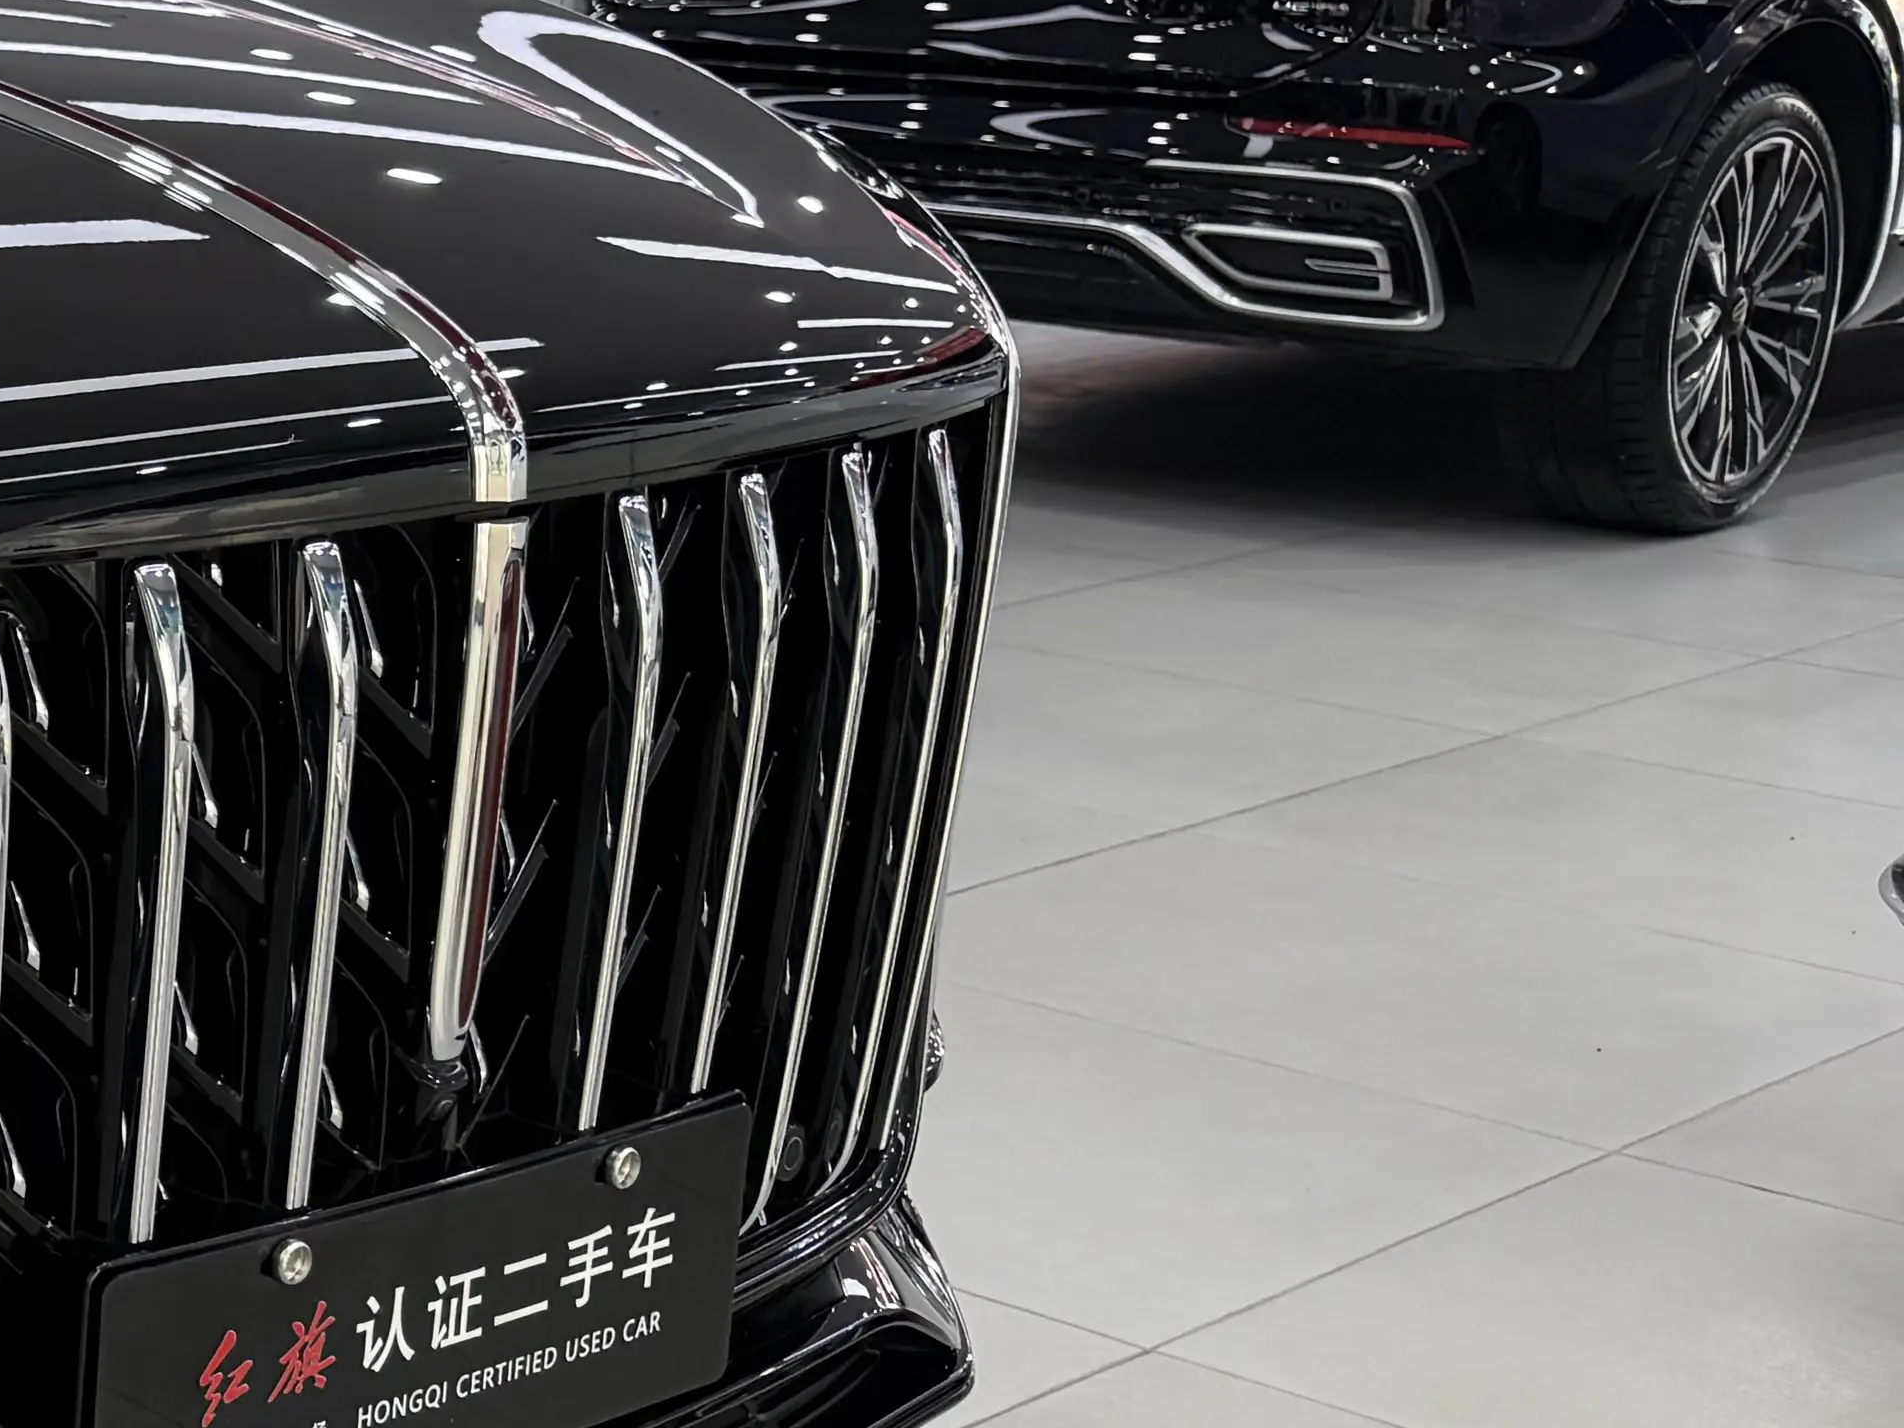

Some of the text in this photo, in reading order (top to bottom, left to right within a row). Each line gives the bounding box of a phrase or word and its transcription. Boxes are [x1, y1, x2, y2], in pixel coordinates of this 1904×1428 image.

[197, 1206, 676, 1428] 红旗 认证二手车
[457, 1347, 558, 1400] CERTIFIED
[564, 1328, 615, 1363] USED
[623, 1310, 662, 1344] CAR
